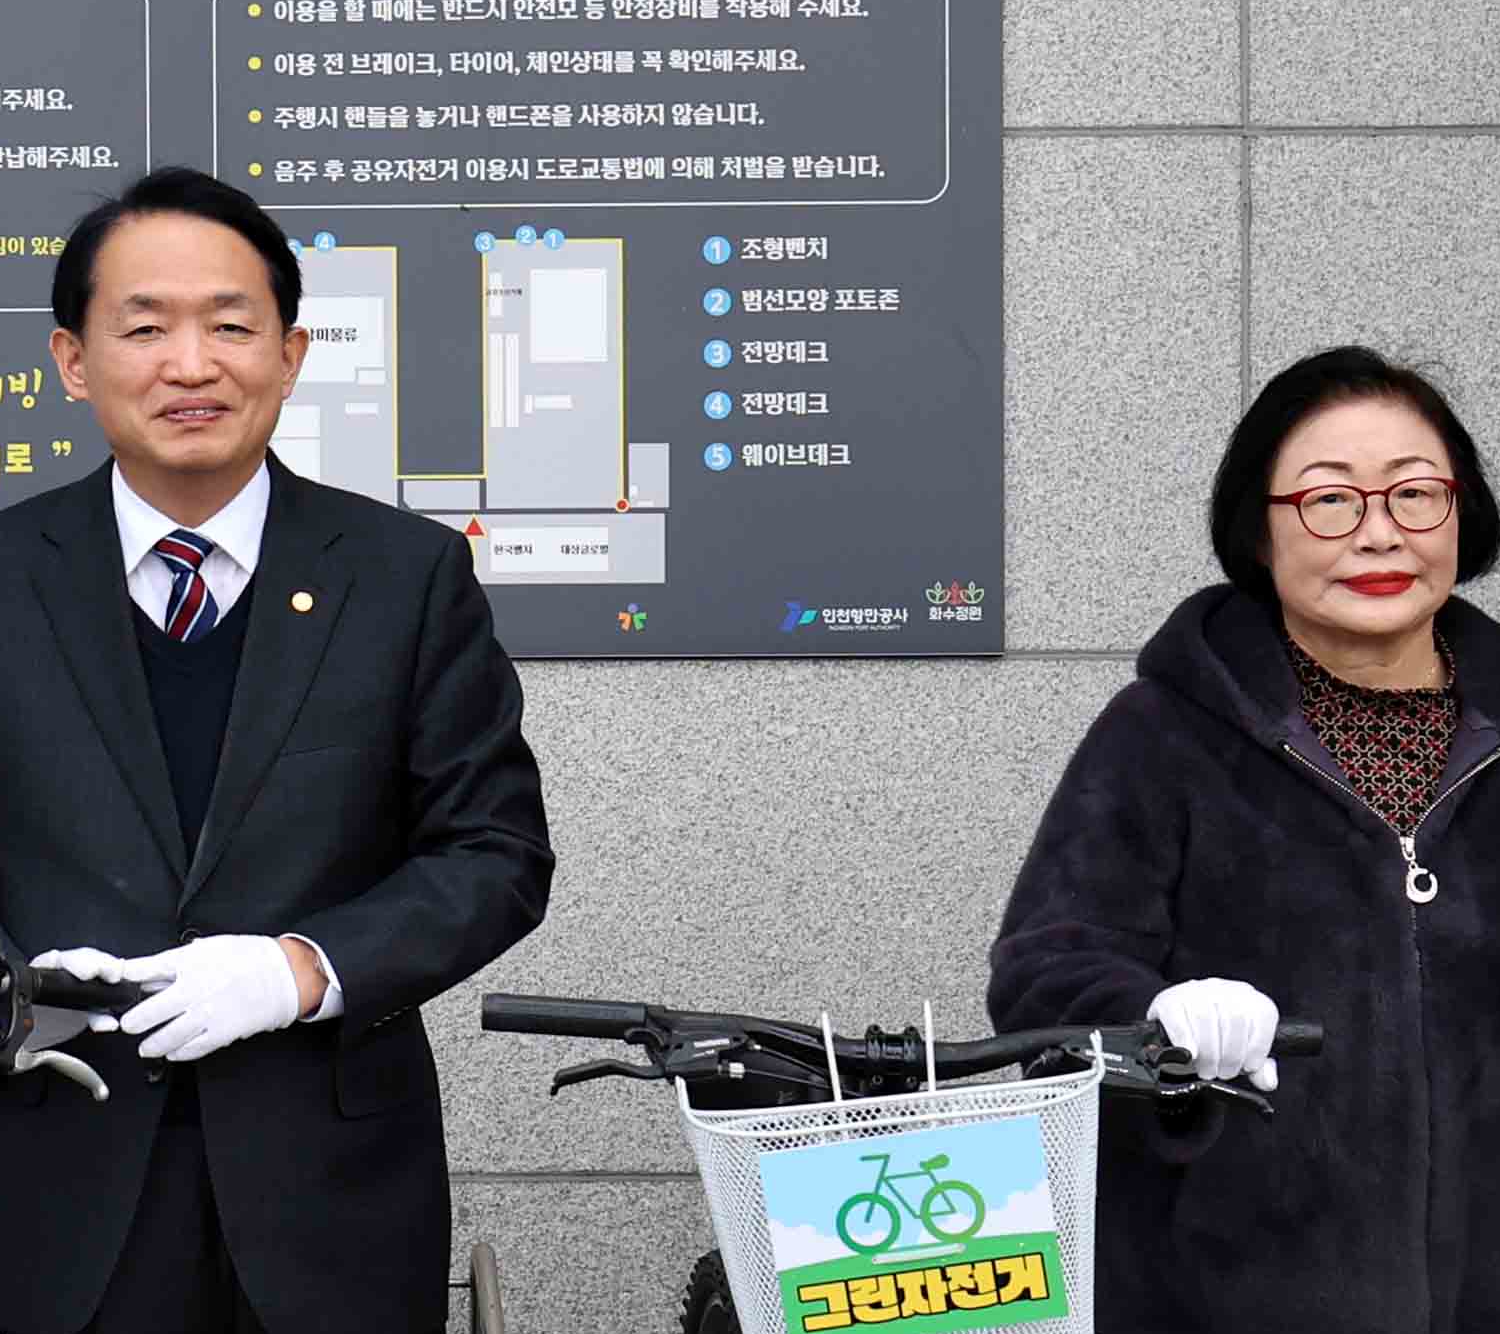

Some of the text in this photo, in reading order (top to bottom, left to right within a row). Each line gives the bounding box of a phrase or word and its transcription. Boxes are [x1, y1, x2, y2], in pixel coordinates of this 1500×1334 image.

[273, 0, 339, 23] 이용을
[343, 0, 367, 22] 할
[274, 49, 806, 77] 이용 전 브레이크, 타이어, 체인상태를 꼭 확인해주세요.
[273, 102, 765, 130] 주행시 핸들을 놓거나 핸드폰을 사용하지 않습니다.
[274, 154, 885, 183] 음주 후 공유자전거 이용시 도로교통법에 의해 처벌을 받습니다.
[741, 237, 828, 261] 조형벤치
[741, 288, 829, 312] 범선모양
[834, 289, 900, 311] 포토존
[310, 327, 357, 342] 미물류
[741, 340, 829, 364] 전망데크
[741, 391, 829, 416] 전망데크
[741, 443, 851, 467] 웨이브데크
[822, 608, 908, 625] 인천항만공사
[928, 606, 982, 621] 화수정원
[798, 1252, 1050, 1333] 그린자전거
